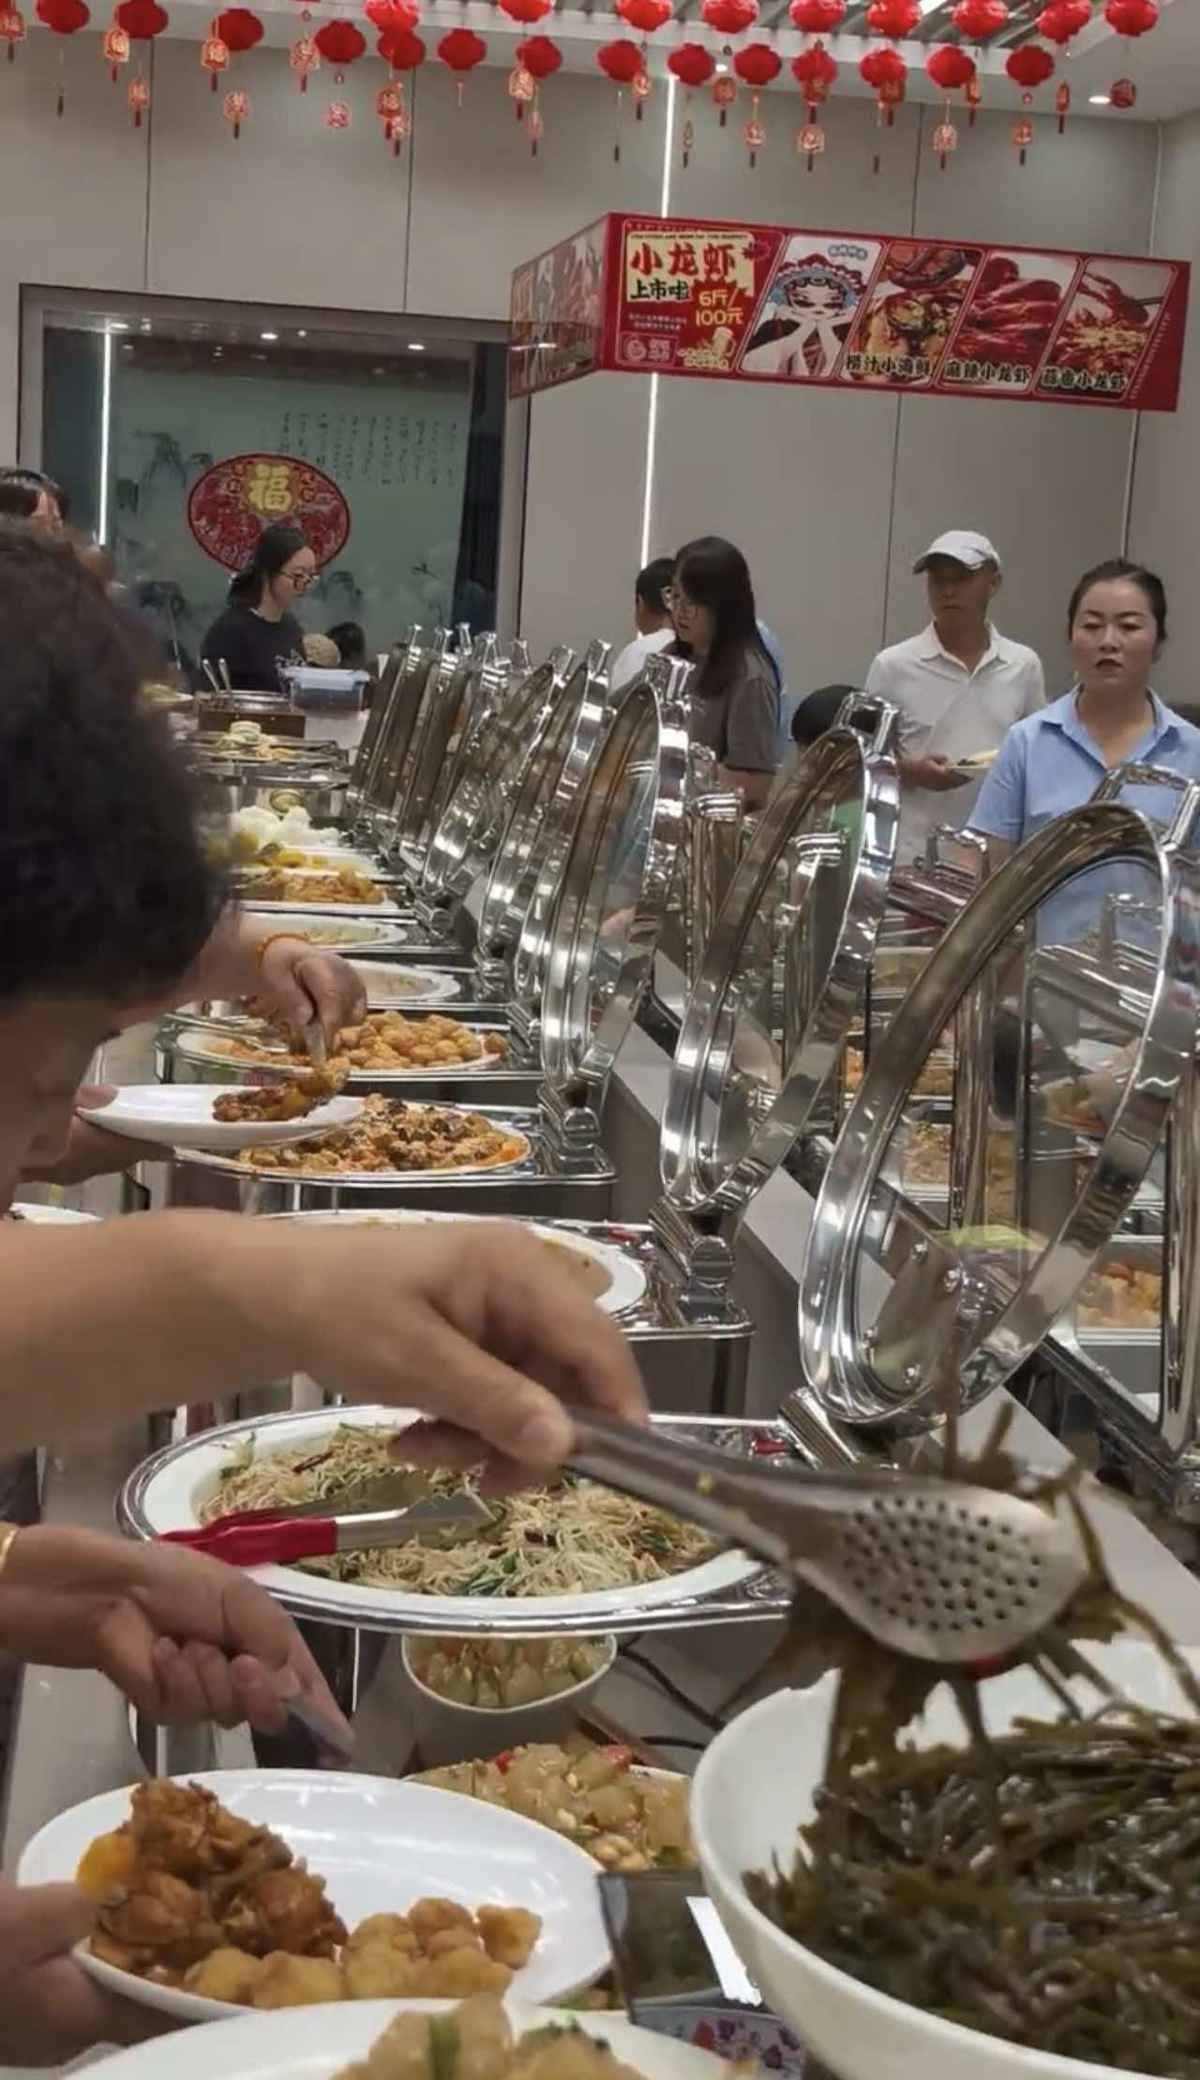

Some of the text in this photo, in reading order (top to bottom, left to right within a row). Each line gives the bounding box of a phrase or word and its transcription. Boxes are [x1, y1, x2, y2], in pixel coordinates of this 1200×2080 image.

[630, 242, 735, 275] 小龙虾
[630, 278, 689, 299] 上市啦
[699, 288, 740, 306] 6斤/
[695, 307, 743, 326] 100元
[946, 360, 1029, 384] 麻辣小龙虾
[248, 463, 292, 513] 福
